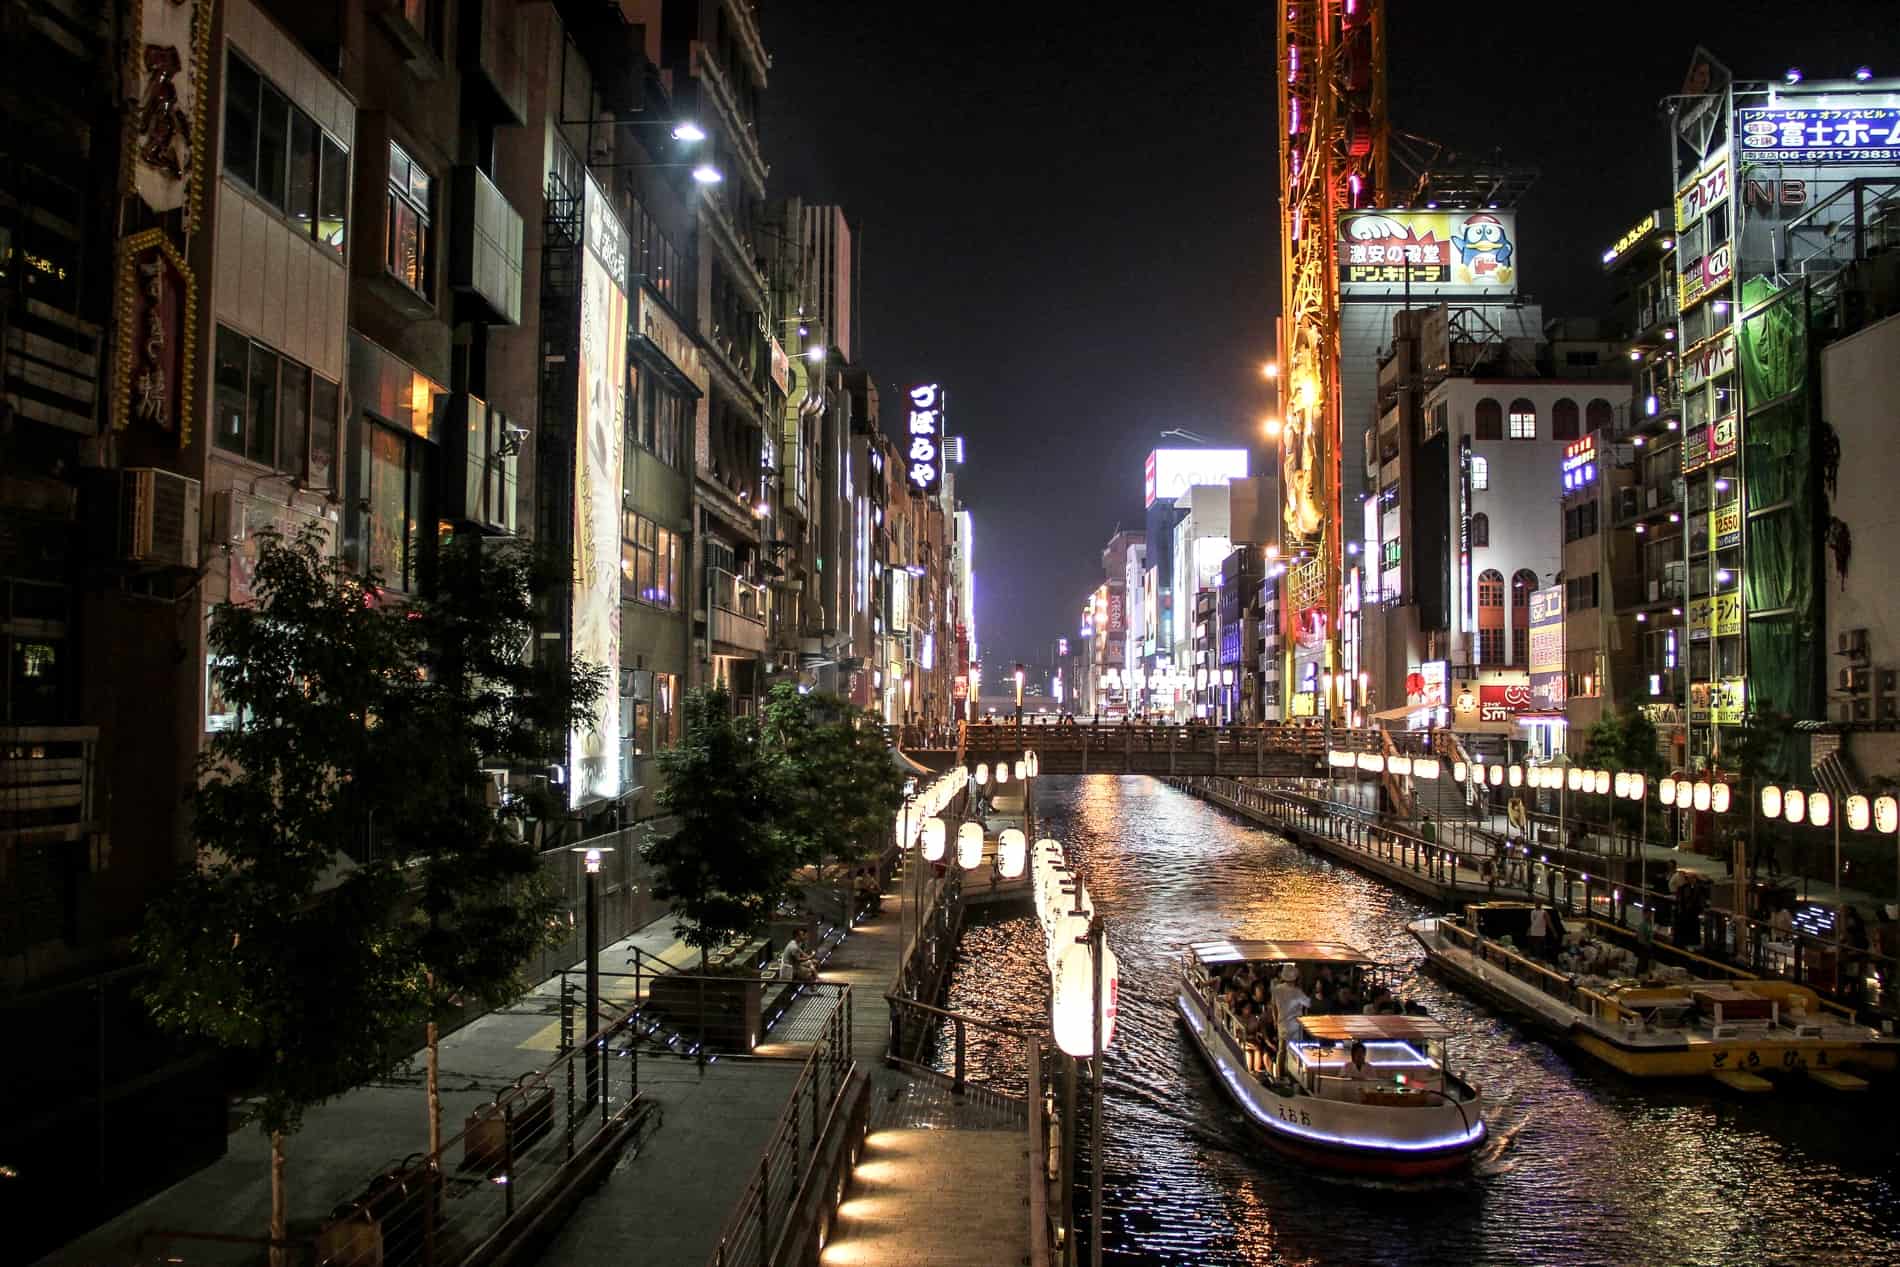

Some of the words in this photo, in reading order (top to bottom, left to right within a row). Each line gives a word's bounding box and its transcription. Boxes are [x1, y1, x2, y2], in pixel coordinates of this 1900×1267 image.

[1350, 244, 1441, 263] 激安の殿堂
[910, 384, 939, 488] づぼらや
